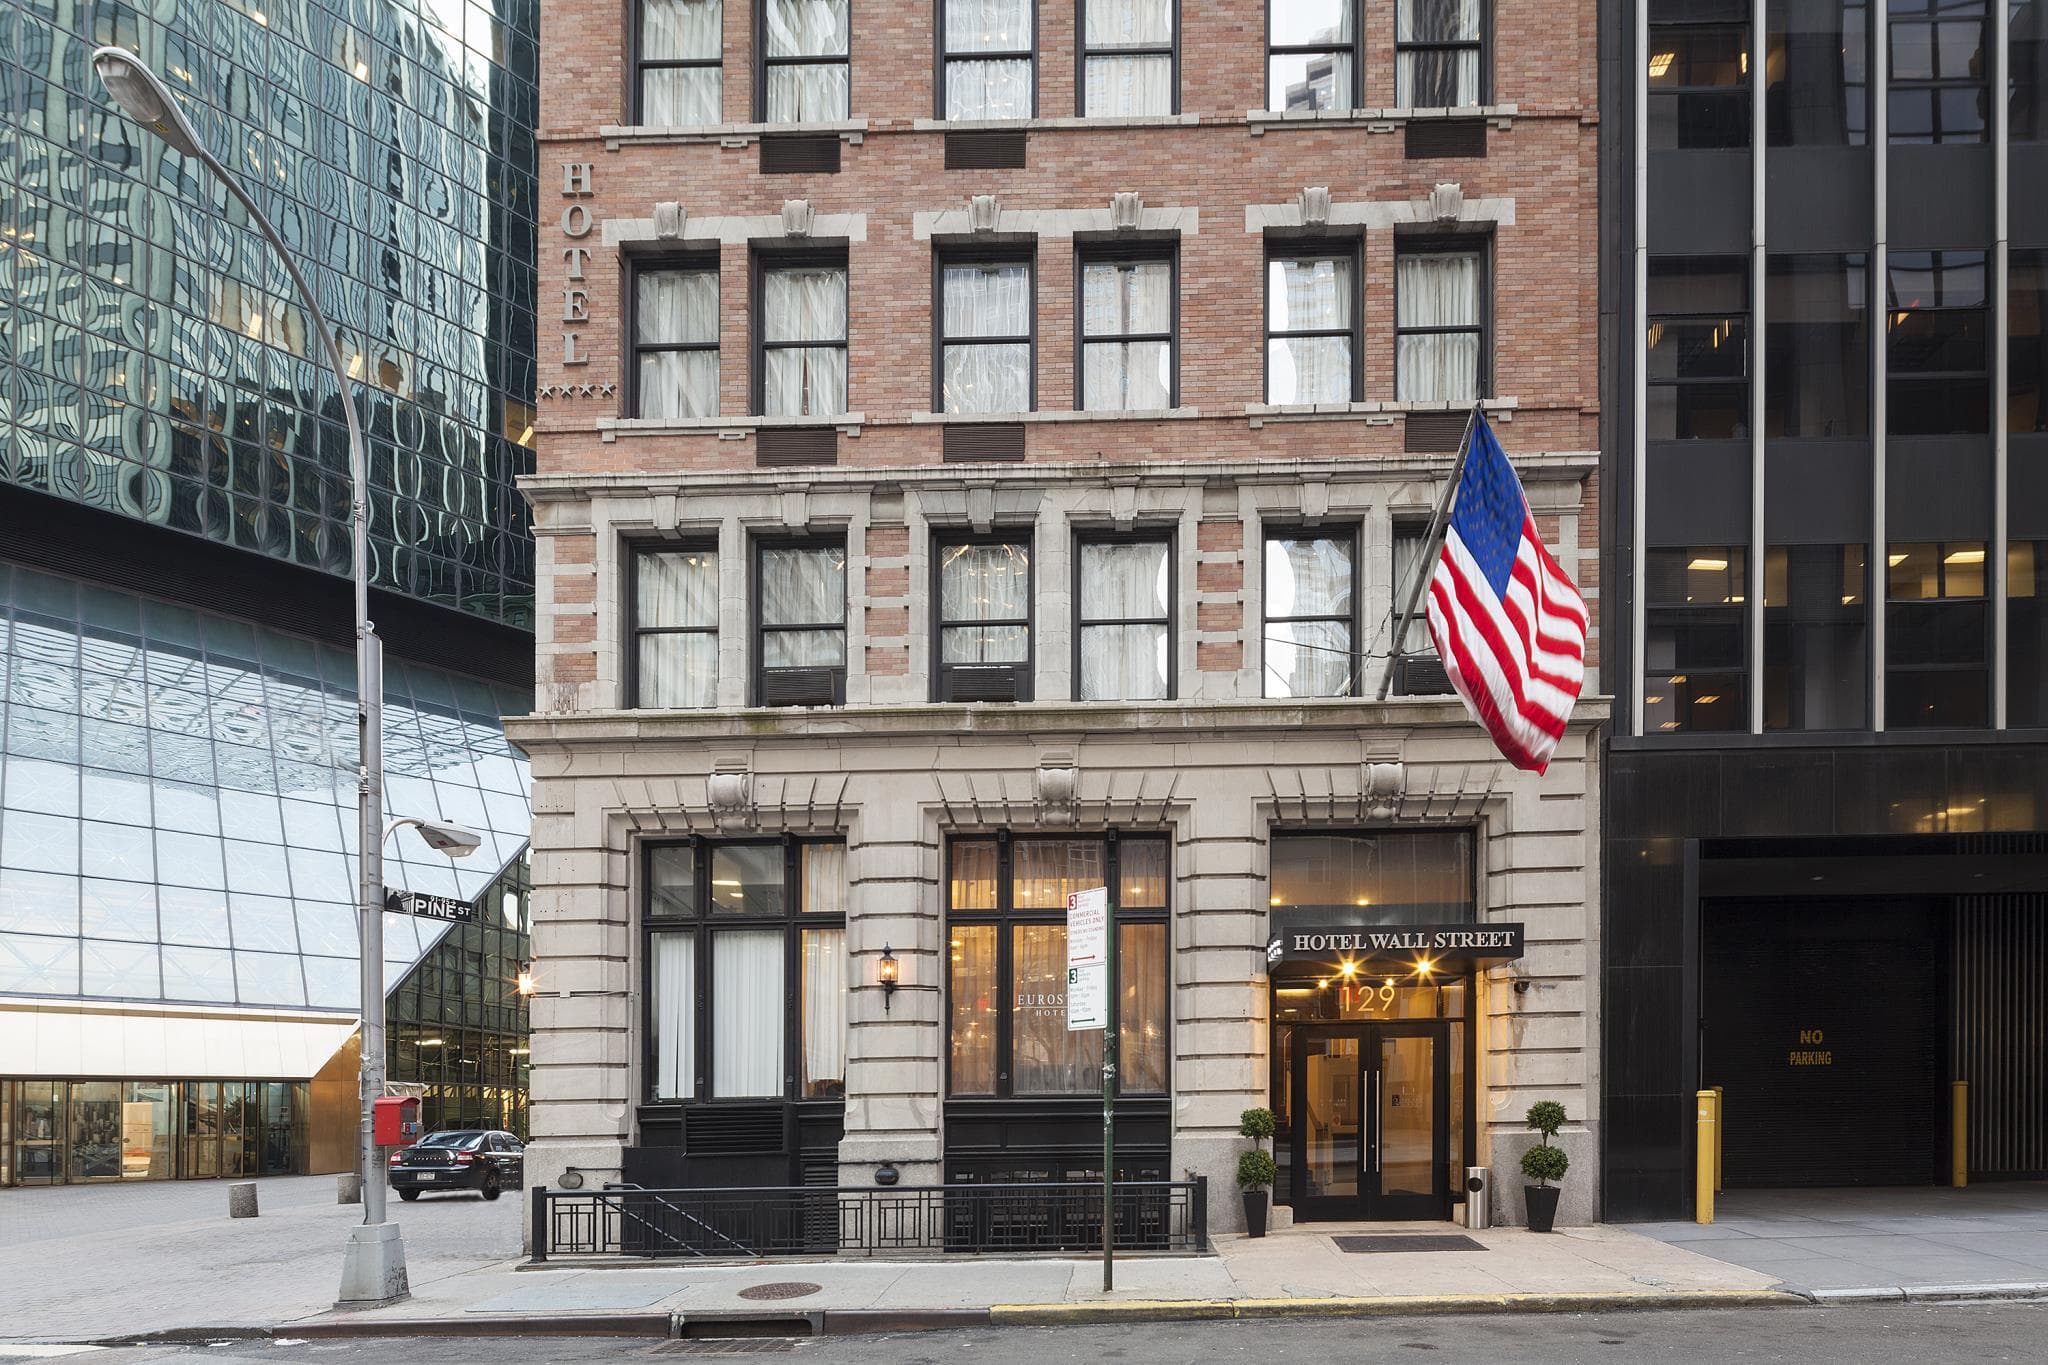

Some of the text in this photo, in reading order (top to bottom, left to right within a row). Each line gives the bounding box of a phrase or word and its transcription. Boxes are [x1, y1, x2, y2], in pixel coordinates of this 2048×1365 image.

[561, 162, 594, 367] HOTEL
[415, 898, 471, 919] PINE ST
[1069, 895, 1077, 909] 3
[1069, 908, 1099, 920] COMMERCIAL
[1070, 916, 1105, 927] VEHICLES ONLY
[1294, 933, 1367, 951] HOTEL
[1369, 932, 1430, 949] WALL
[1434, 931, 1515, 948] STREET
[1070, 969, 1077, 983] 3
[1018, 994, 1068, 1005] EUROS
[1342, 985, 1395, 1013] 129
[1800, 1029, 1823, 1045] NO
[1790, 1051, 1832, 1066] PARKING
